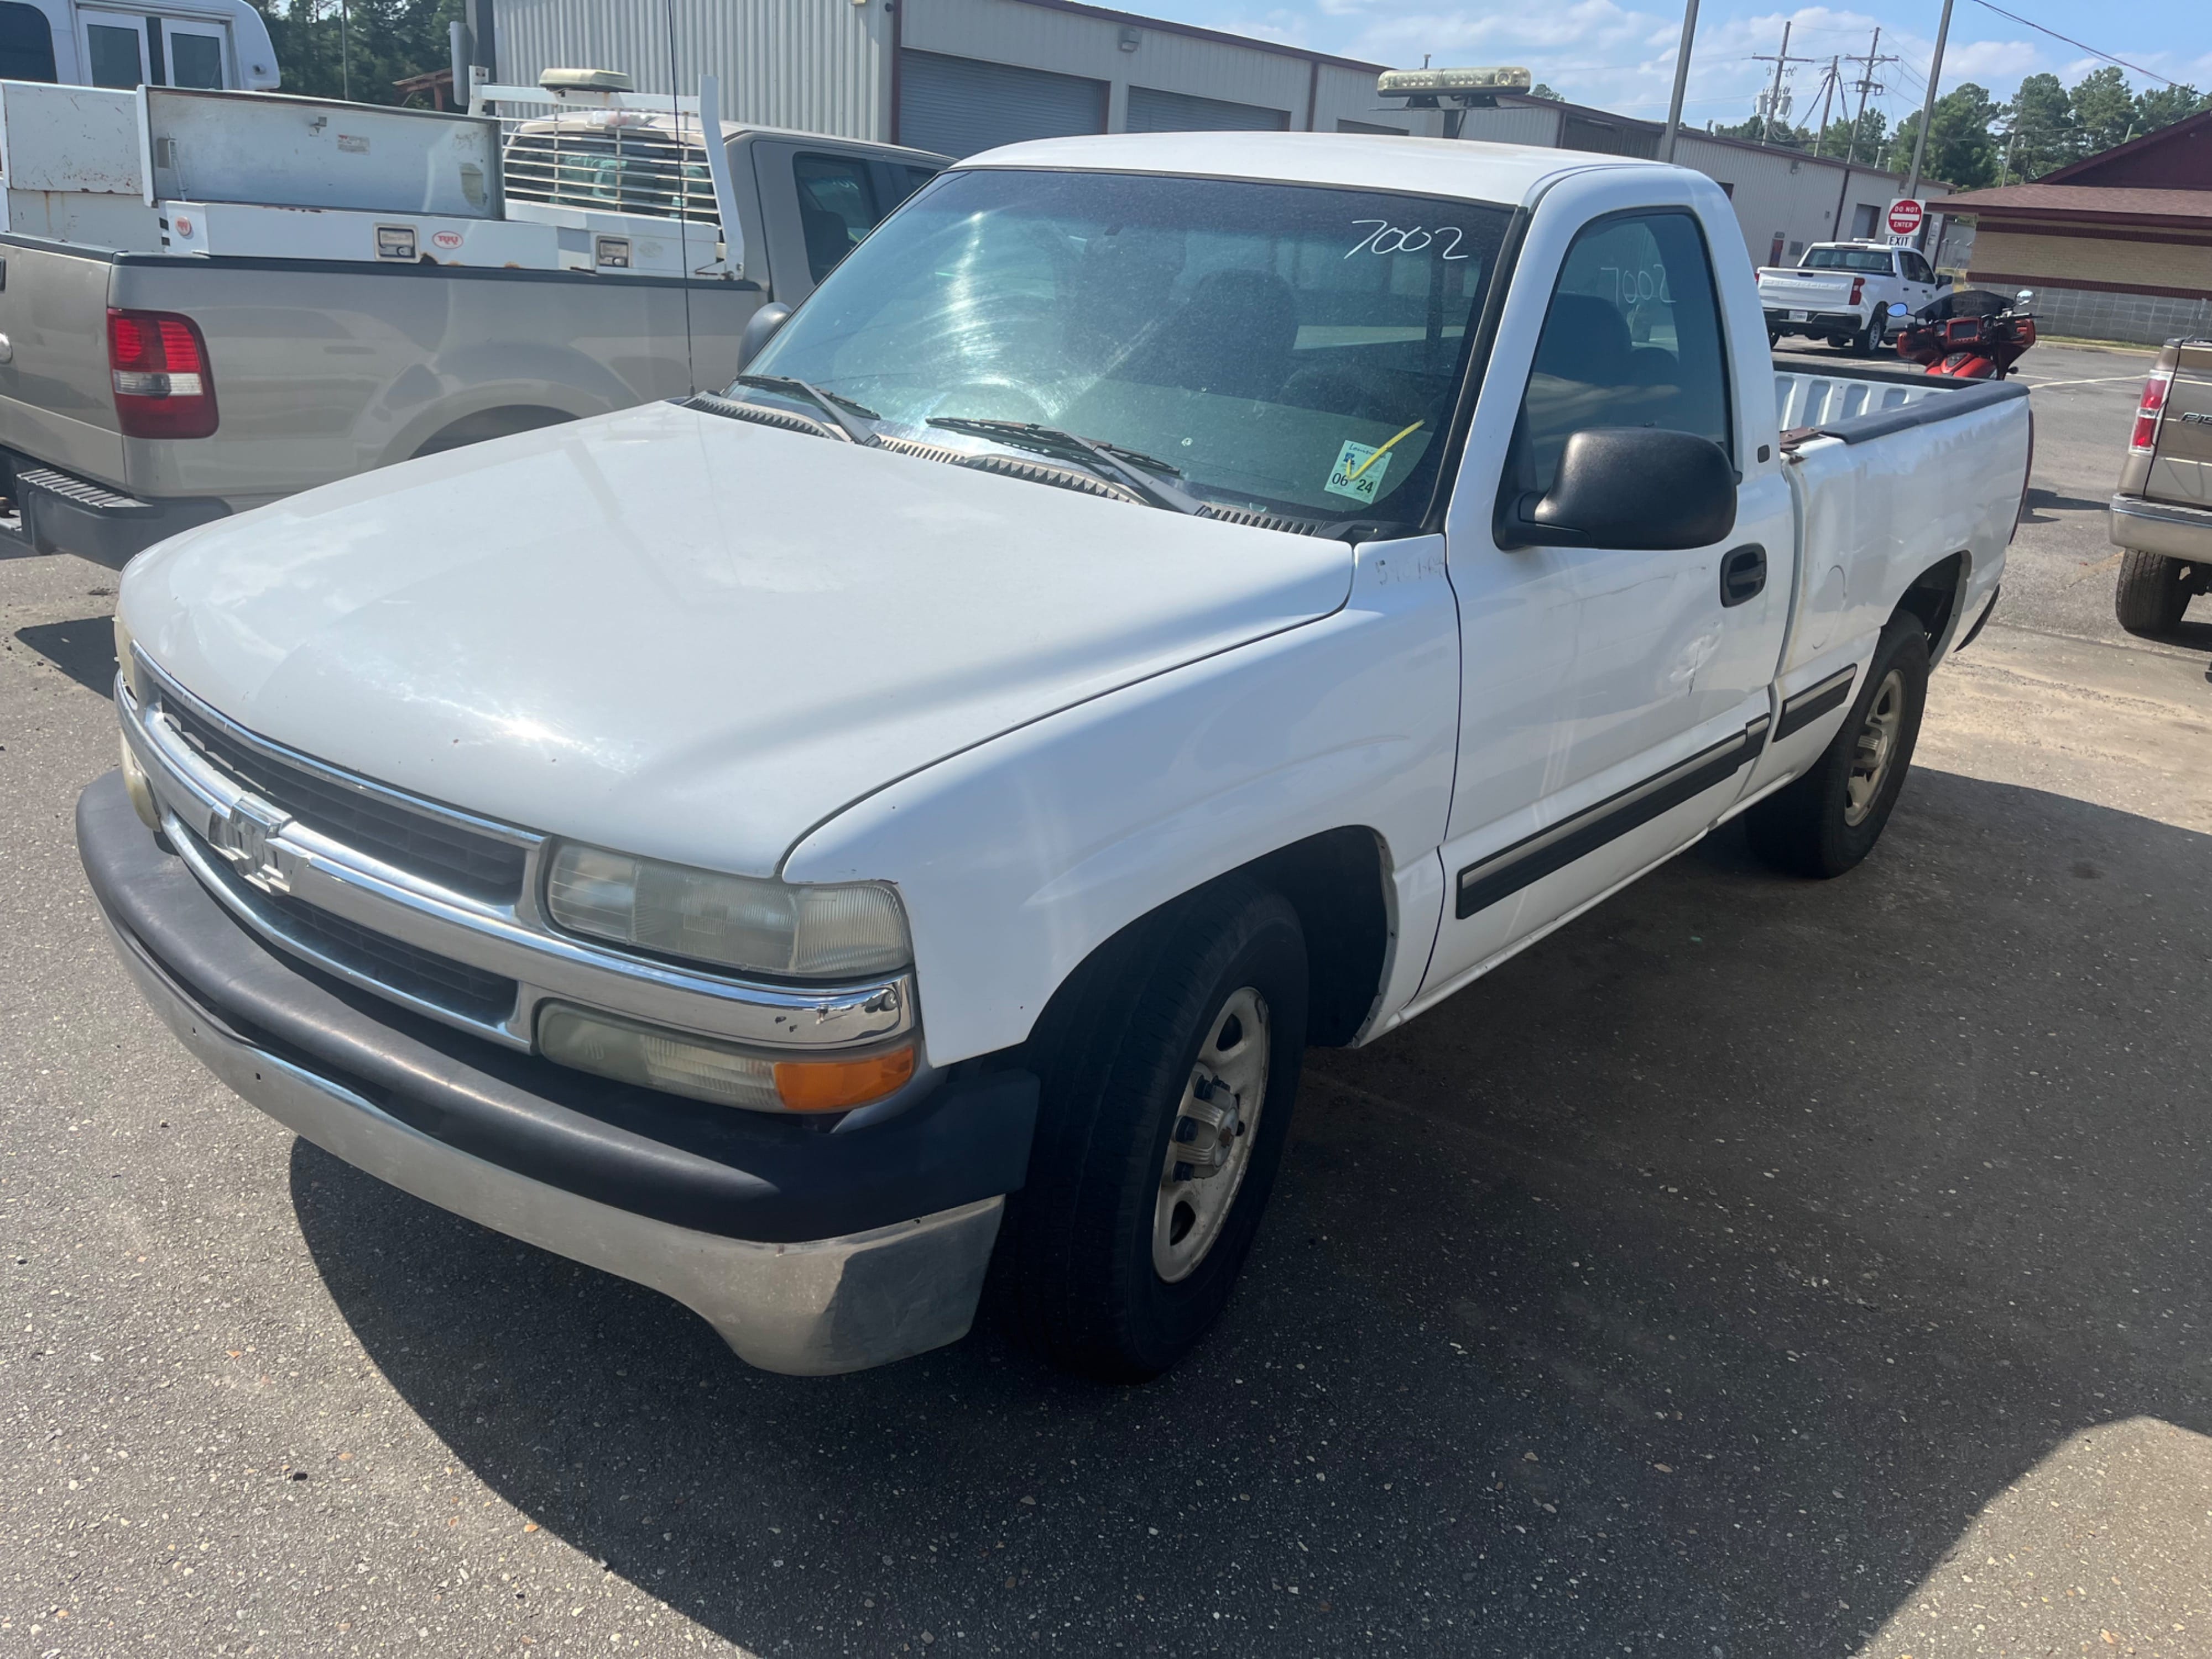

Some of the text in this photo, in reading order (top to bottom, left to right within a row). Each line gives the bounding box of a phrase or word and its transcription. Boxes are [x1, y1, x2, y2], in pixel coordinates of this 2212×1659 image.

[1343, 219, 1469, 260] 7002
[1889, 236, 1910, 246] EXIT
[1600, 263, 1677, 308] 7002
[1332, 473, 1374, 493] 06 24
